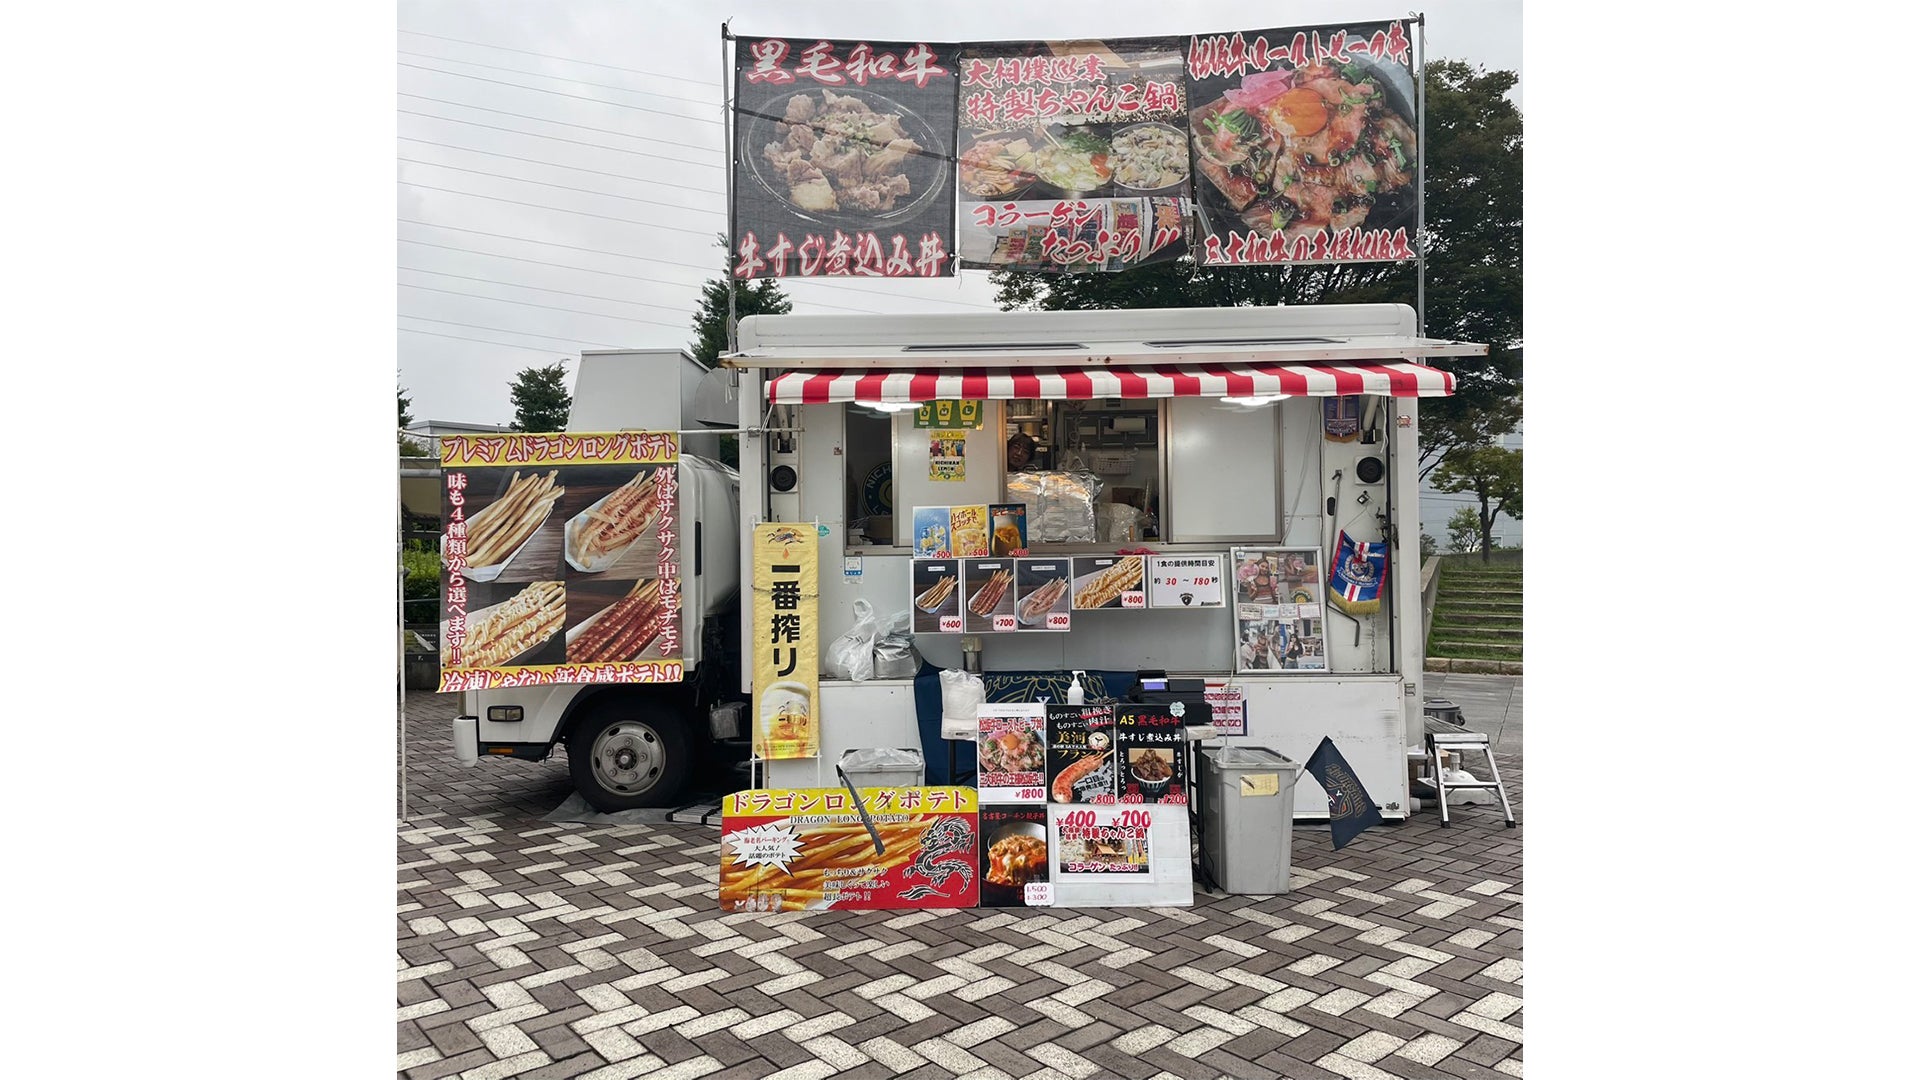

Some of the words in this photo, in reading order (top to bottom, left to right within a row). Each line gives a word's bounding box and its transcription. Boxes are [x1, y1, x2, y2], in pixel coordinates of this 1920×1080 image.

[746, 38, 948, 88] 黒毛和牛
[962, 53, 1107, 87] 大相撲巡業
[966, 81, 1179, 123] 特製ちゃんこ鍋
[973, 201, 1102, 227] コラーゲン
[734, 230, 949, 278] 牛すじ煮込み丼
[442, 435, 676, 463] プレミアムドラゴンロングポテト
[654, 466, 679, 657] 外はサクサク中はモチモチ
[1156, 559, 1216, 568] 1食の提供時間目安
[446, 473, 468, 664] 味も4種類から選べます!!
[1153, 577, 1161, 585] 約
[1165, 577, 1177, 586] 30
[1193, 577, 1210, 586] 180
[1124, 595, 1143, 604] ¥800
[771, 564, 801, 677] 一番搾り
[942, 620, 961, 629] ¥600
[995, 618, 1014, 627] ¥700
[1048, 616, 1068, 625] ¥800
[1119, 715, 1135, 725] A5
[1137, 715, 1181, 726] 黒毛和牛
[1119, 732, 1182, 743] 牛すじ煮込み丼
[1015, 788, 1044, 799] ¥1800
[790, 815, 831, 824] DRAGON
[837, 815, 864, 824] LONG
[871, 814, 909, 823] POTATO
[1056, 810, 1097, 828] ¥400
[1112, 809, 1152, 828] ¥700
[1082, 827, 1145, 839] 特製ちゃんこ鍋
[1068, 862, 1106, 872] コラーゲン
